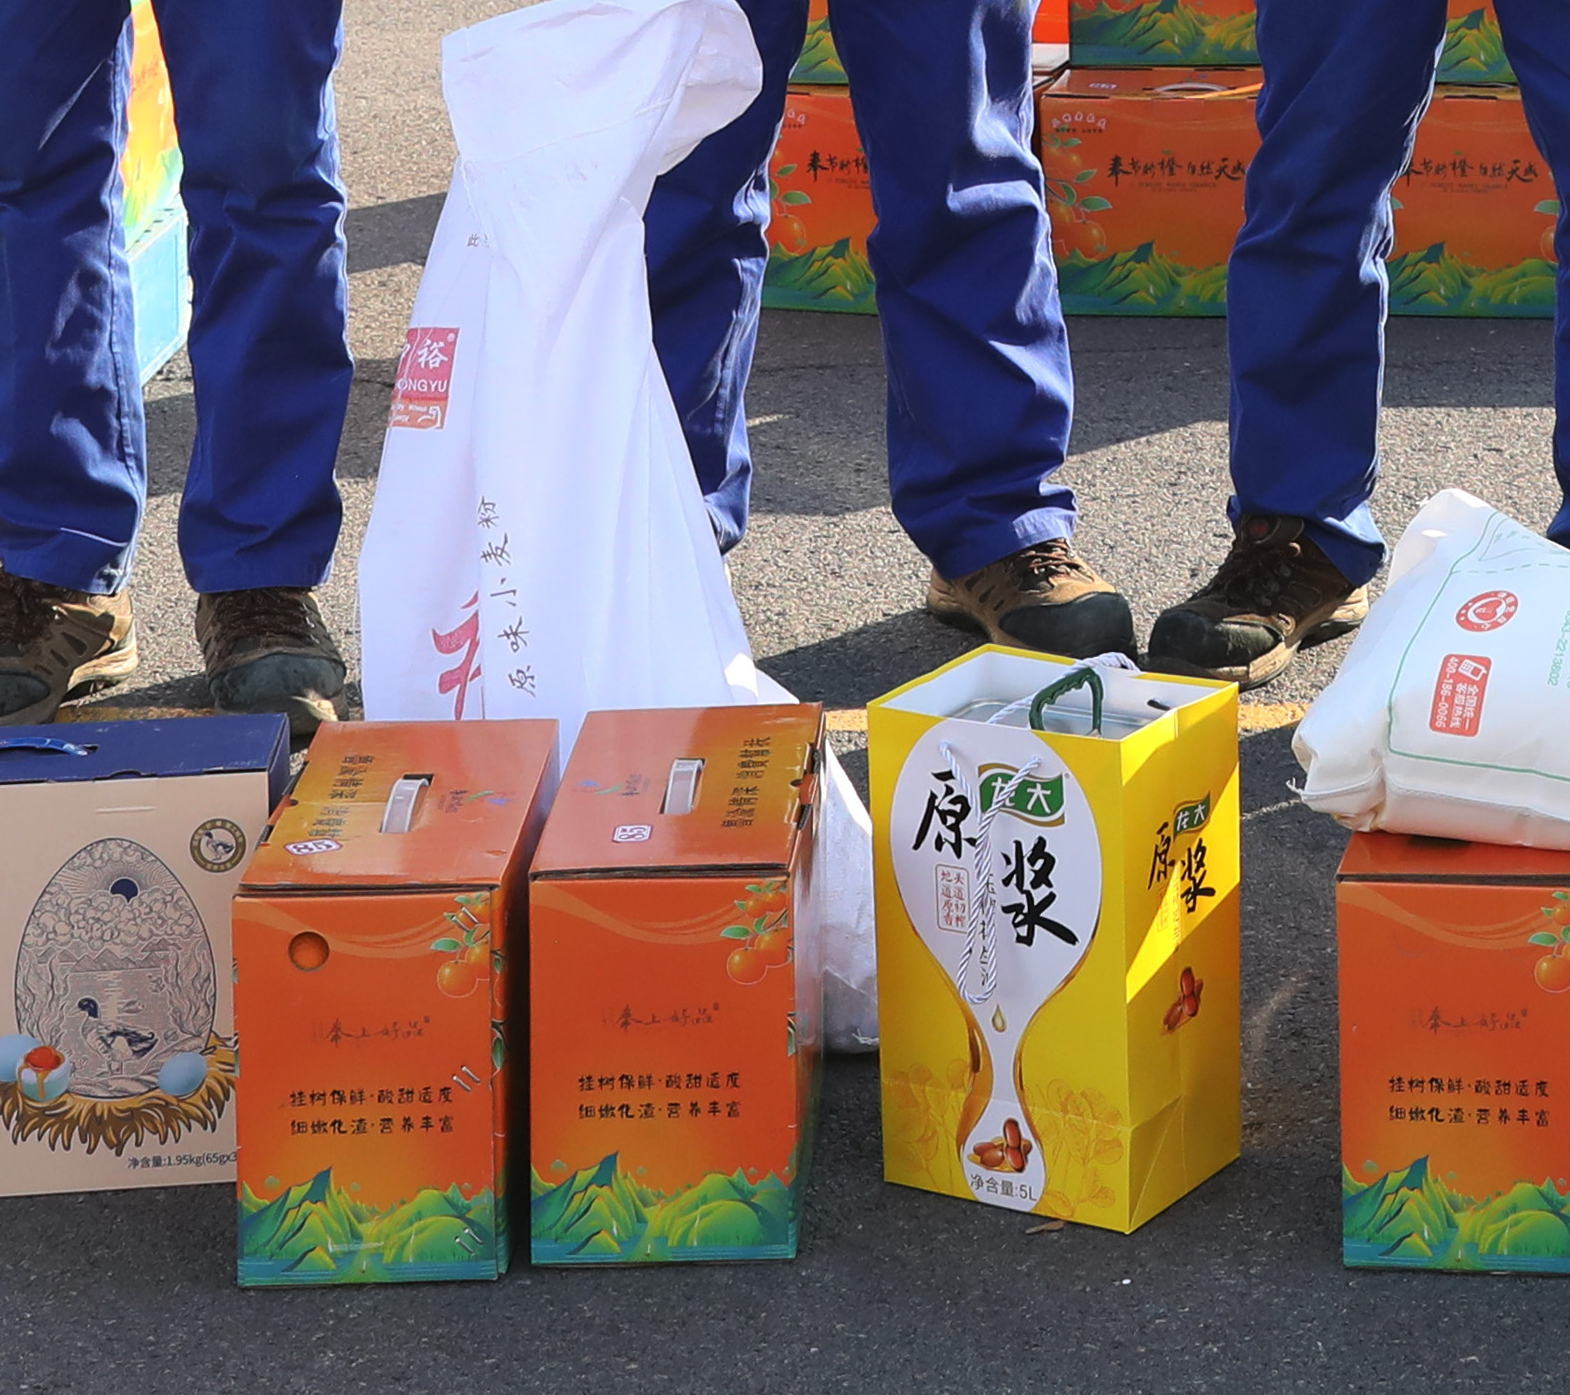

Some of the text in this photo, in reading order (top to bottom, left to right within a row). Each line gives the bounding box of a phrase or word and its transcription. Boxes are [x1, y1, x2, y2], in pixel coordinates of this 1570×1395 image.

[396, 377, 447, 393] ONGYU
[478, 497, 537, 698] 原味小麦粉
[1176, 802, 1205, 833] 龙大
[969, 1172, 1037, 1202] 净含量:5L
